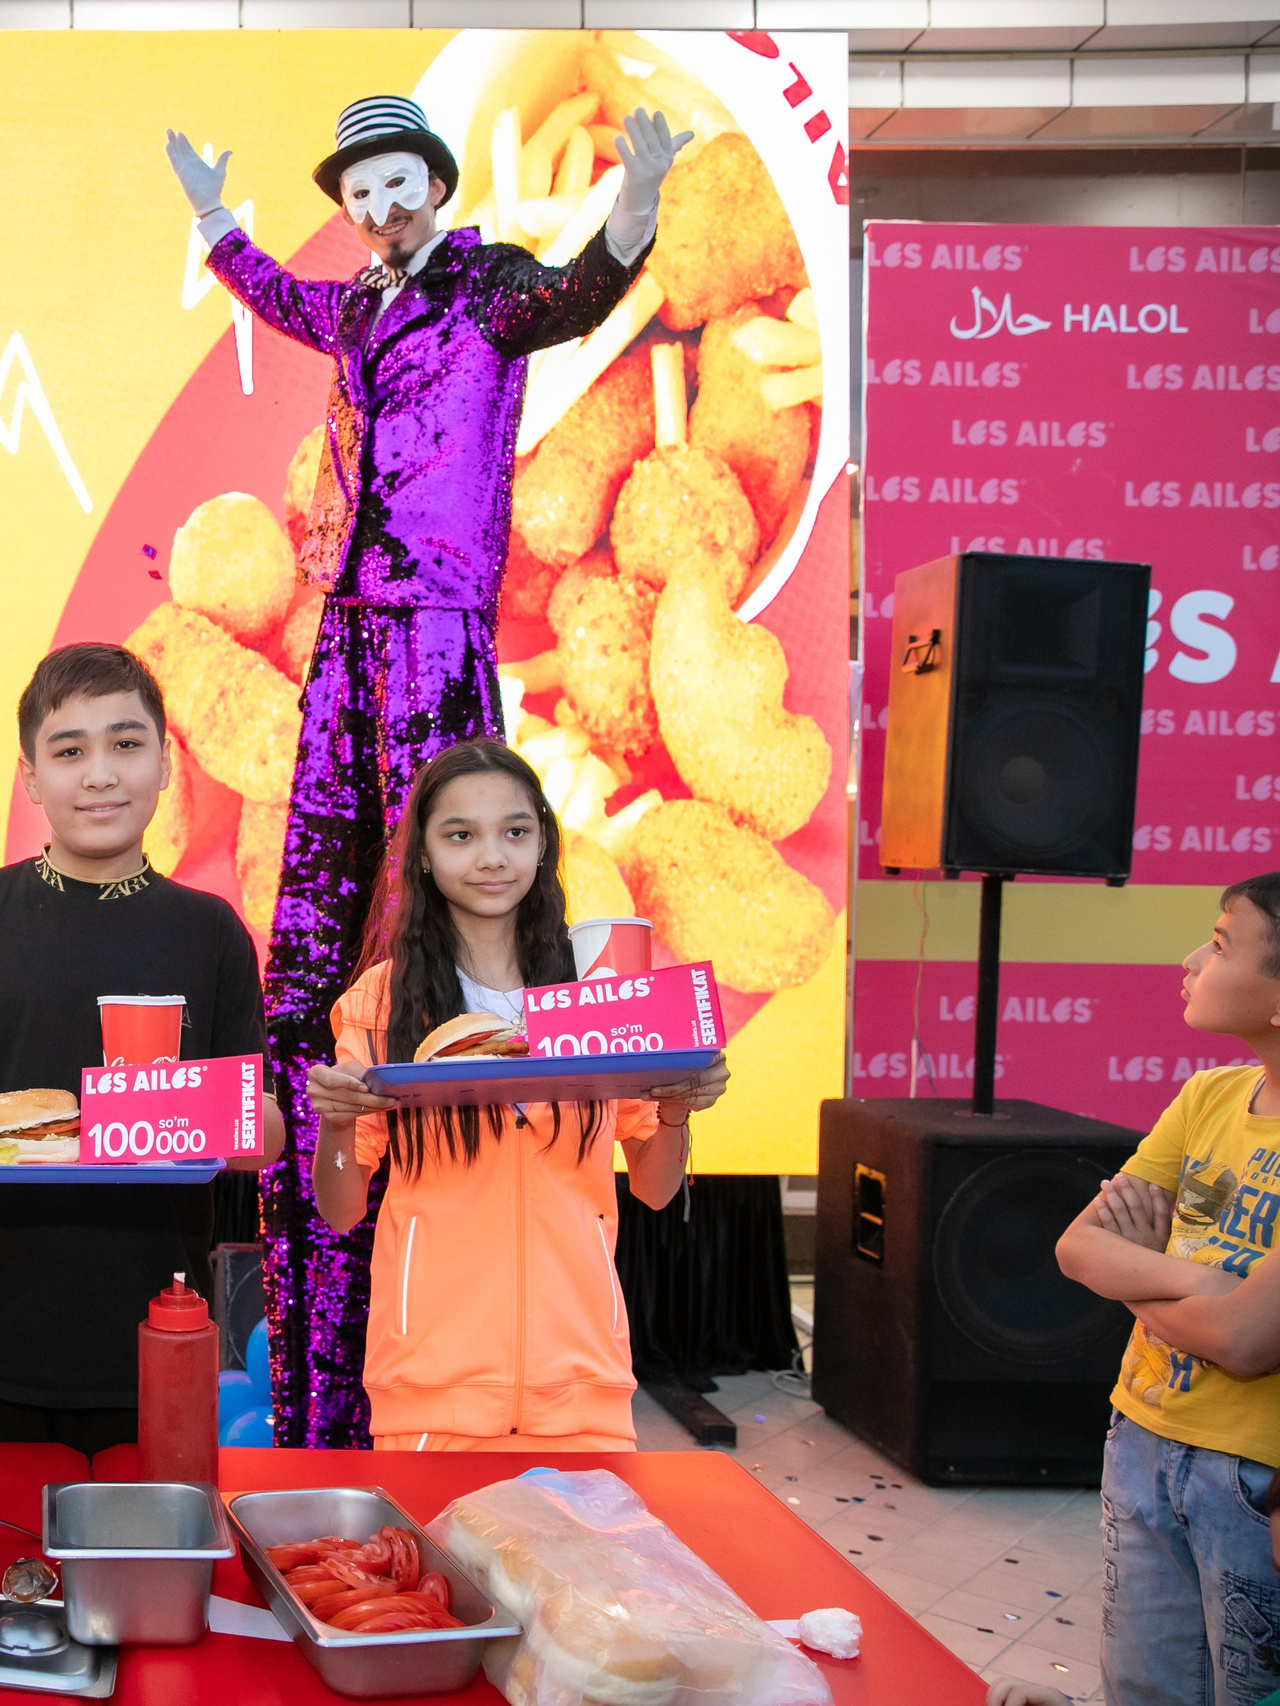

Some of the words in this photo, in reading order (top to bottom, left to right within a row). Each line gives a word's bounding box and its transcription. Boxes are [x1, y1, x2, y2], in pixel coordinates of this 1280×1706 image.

[869, 241, 923, 268] LES
[930, 244, 1023, 271] AILES
[1129, 246, 1186, 272] LES
[949, 285, 1051, 339] حلال
[1064, 304, 1189, 334] HALOL
[1249, 308, 1280, 334] LE
[867, 358, 922, 386] LES
[929, 360, 1021, 388] AILES
[1126, 363, 1183, 390] LES
[952, 419, 1008, 446] LES
[1015, 420, 1107, 447] AILES
[1245, 426, 1280, 453] LE
[865, 475, 920, 502] LES
[928, 477, 1019, 505] AILES
[1124, 481, 1181, 508] LES
[1188, 482, 1280, 509] AILES
[1242, 544, 1280, 571] LE
[865, 592, 895, 620] LE
[1140, 709, 1175, 735] ES
[1183, 710, 1276, 736] AILES
[1132, 825, 1172, 851] ES
[1179, 826, 1272, 853] AILES
[98, 874, 151, 900] ZARA
[527, 989, 572, 1013] LES
[578, 977, 651, 1006] AILES
[690, 968, 718, 1046] SERTIFIKAT
[939, 996, 975, 1021] LE
[1002, 997, 1092, 1023] AILES
[537, 1031, 608, 1057] 100
[610, 1033, 663, 1056] 000
[853, 1052, 907, 1078] LES
[1108, 1056, 1164, 1082] LES
[85, 1072, 127, 1095] LES
[133, 1066, 202, 1092] AILES
[241, 1062, 256, 1150] SERTIFIKAT
[87, 1120, 154, 1158] 100
[155, 1128, 206, 1155] 000
